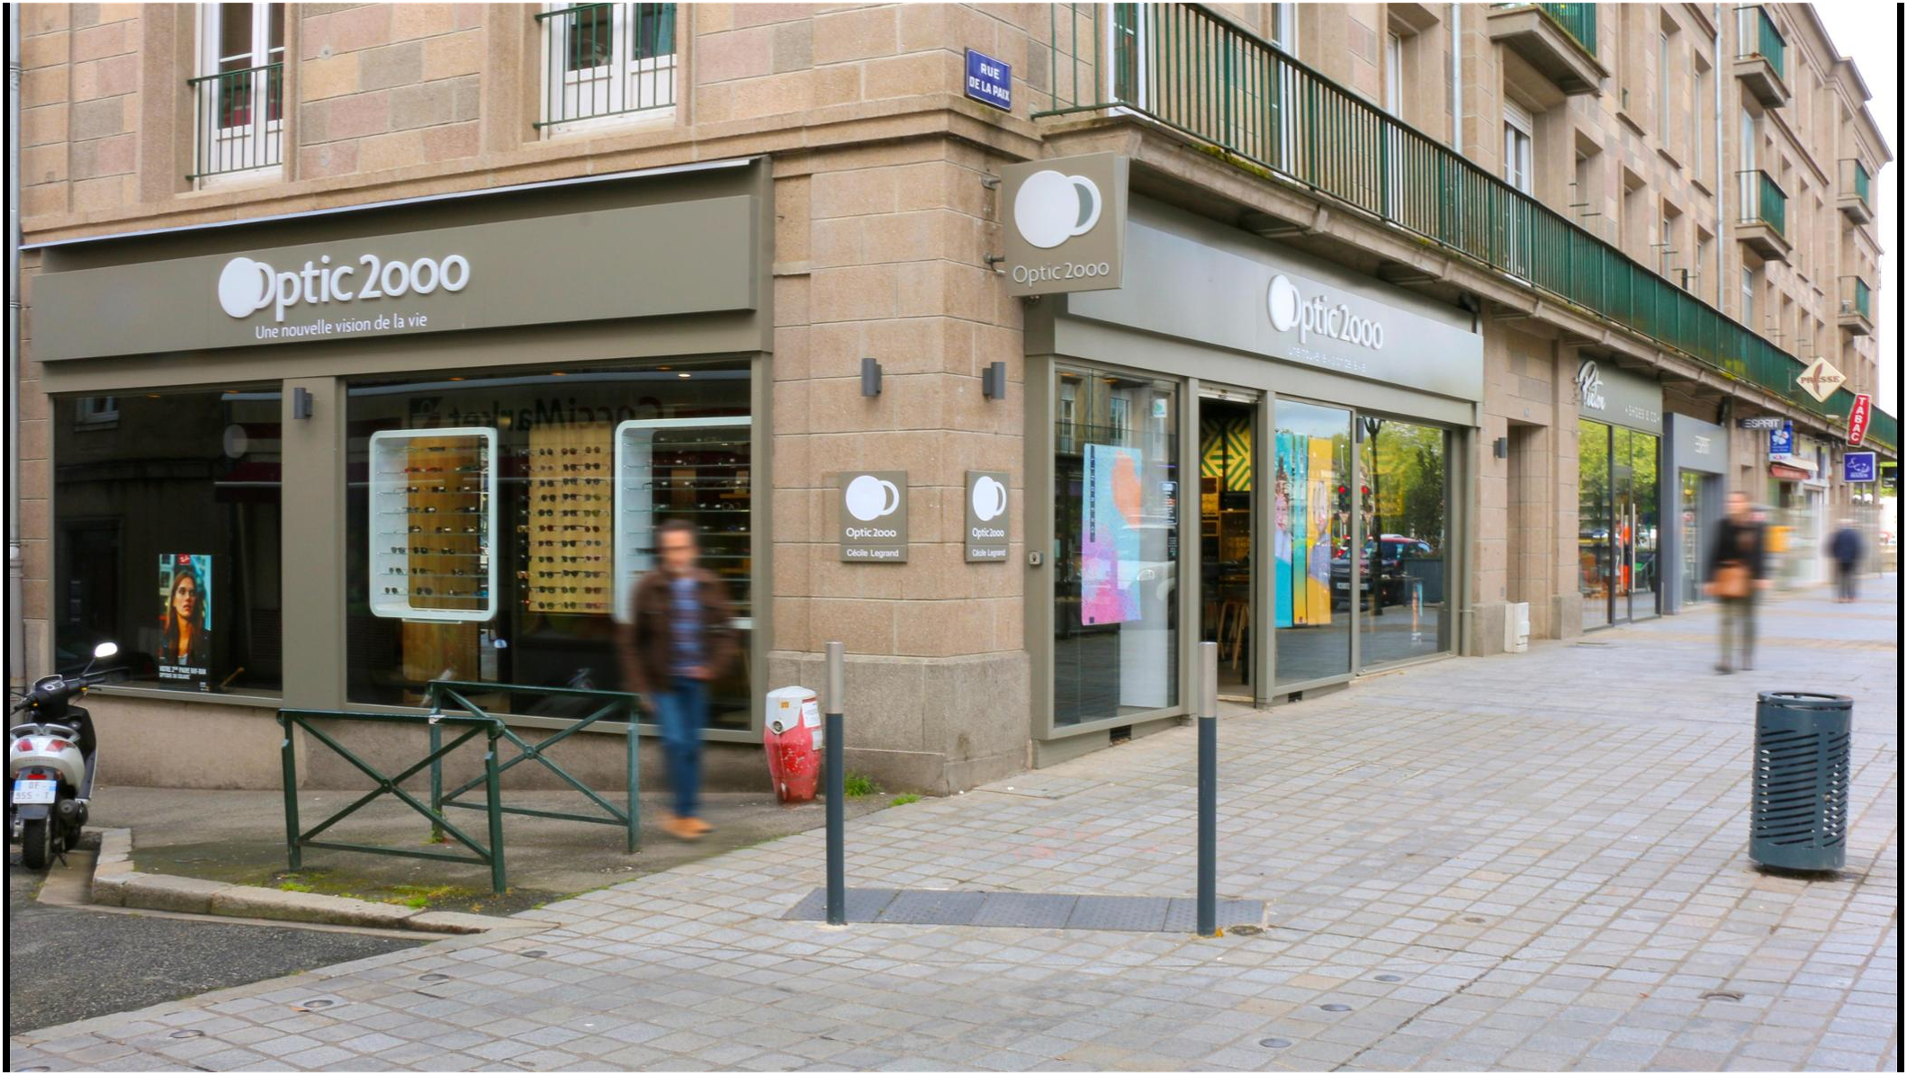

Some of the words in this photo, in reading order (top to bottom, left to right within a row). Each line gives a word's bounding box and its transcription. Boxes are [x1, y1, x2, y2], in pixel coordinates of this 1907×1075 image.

[980, 62, 1000, 80] RUE
[969, 76, 980, 90] DE
[981, 80, 992, 95] LA
[992, 84, 1010, 102] PAIX
[1012, 263, 1061, 287] Optic
[1064, 261, 1110, 280] 2000
[218, 255, 355, 323] Optic
[357, 253, 471, 300] 2000
[1267, 274, 1338, 345] Optic
[255, 325, 279, 339] Une
[281, 319, 333, 337] nouvelle
[335, 317, 371, 334] vision
[374, 314, 391, 330] de
[393, 313, 405, 329] la
[408, 312, 428, 327] vie
[1744, 419, 1780, 428] ESPRIT
[1850, 396, 1867, 442] TABAC
[846, 527, 872, 540] Optic
[972, 527, 990, 540] Optic
[870, 549, 899, 559] Legrand
